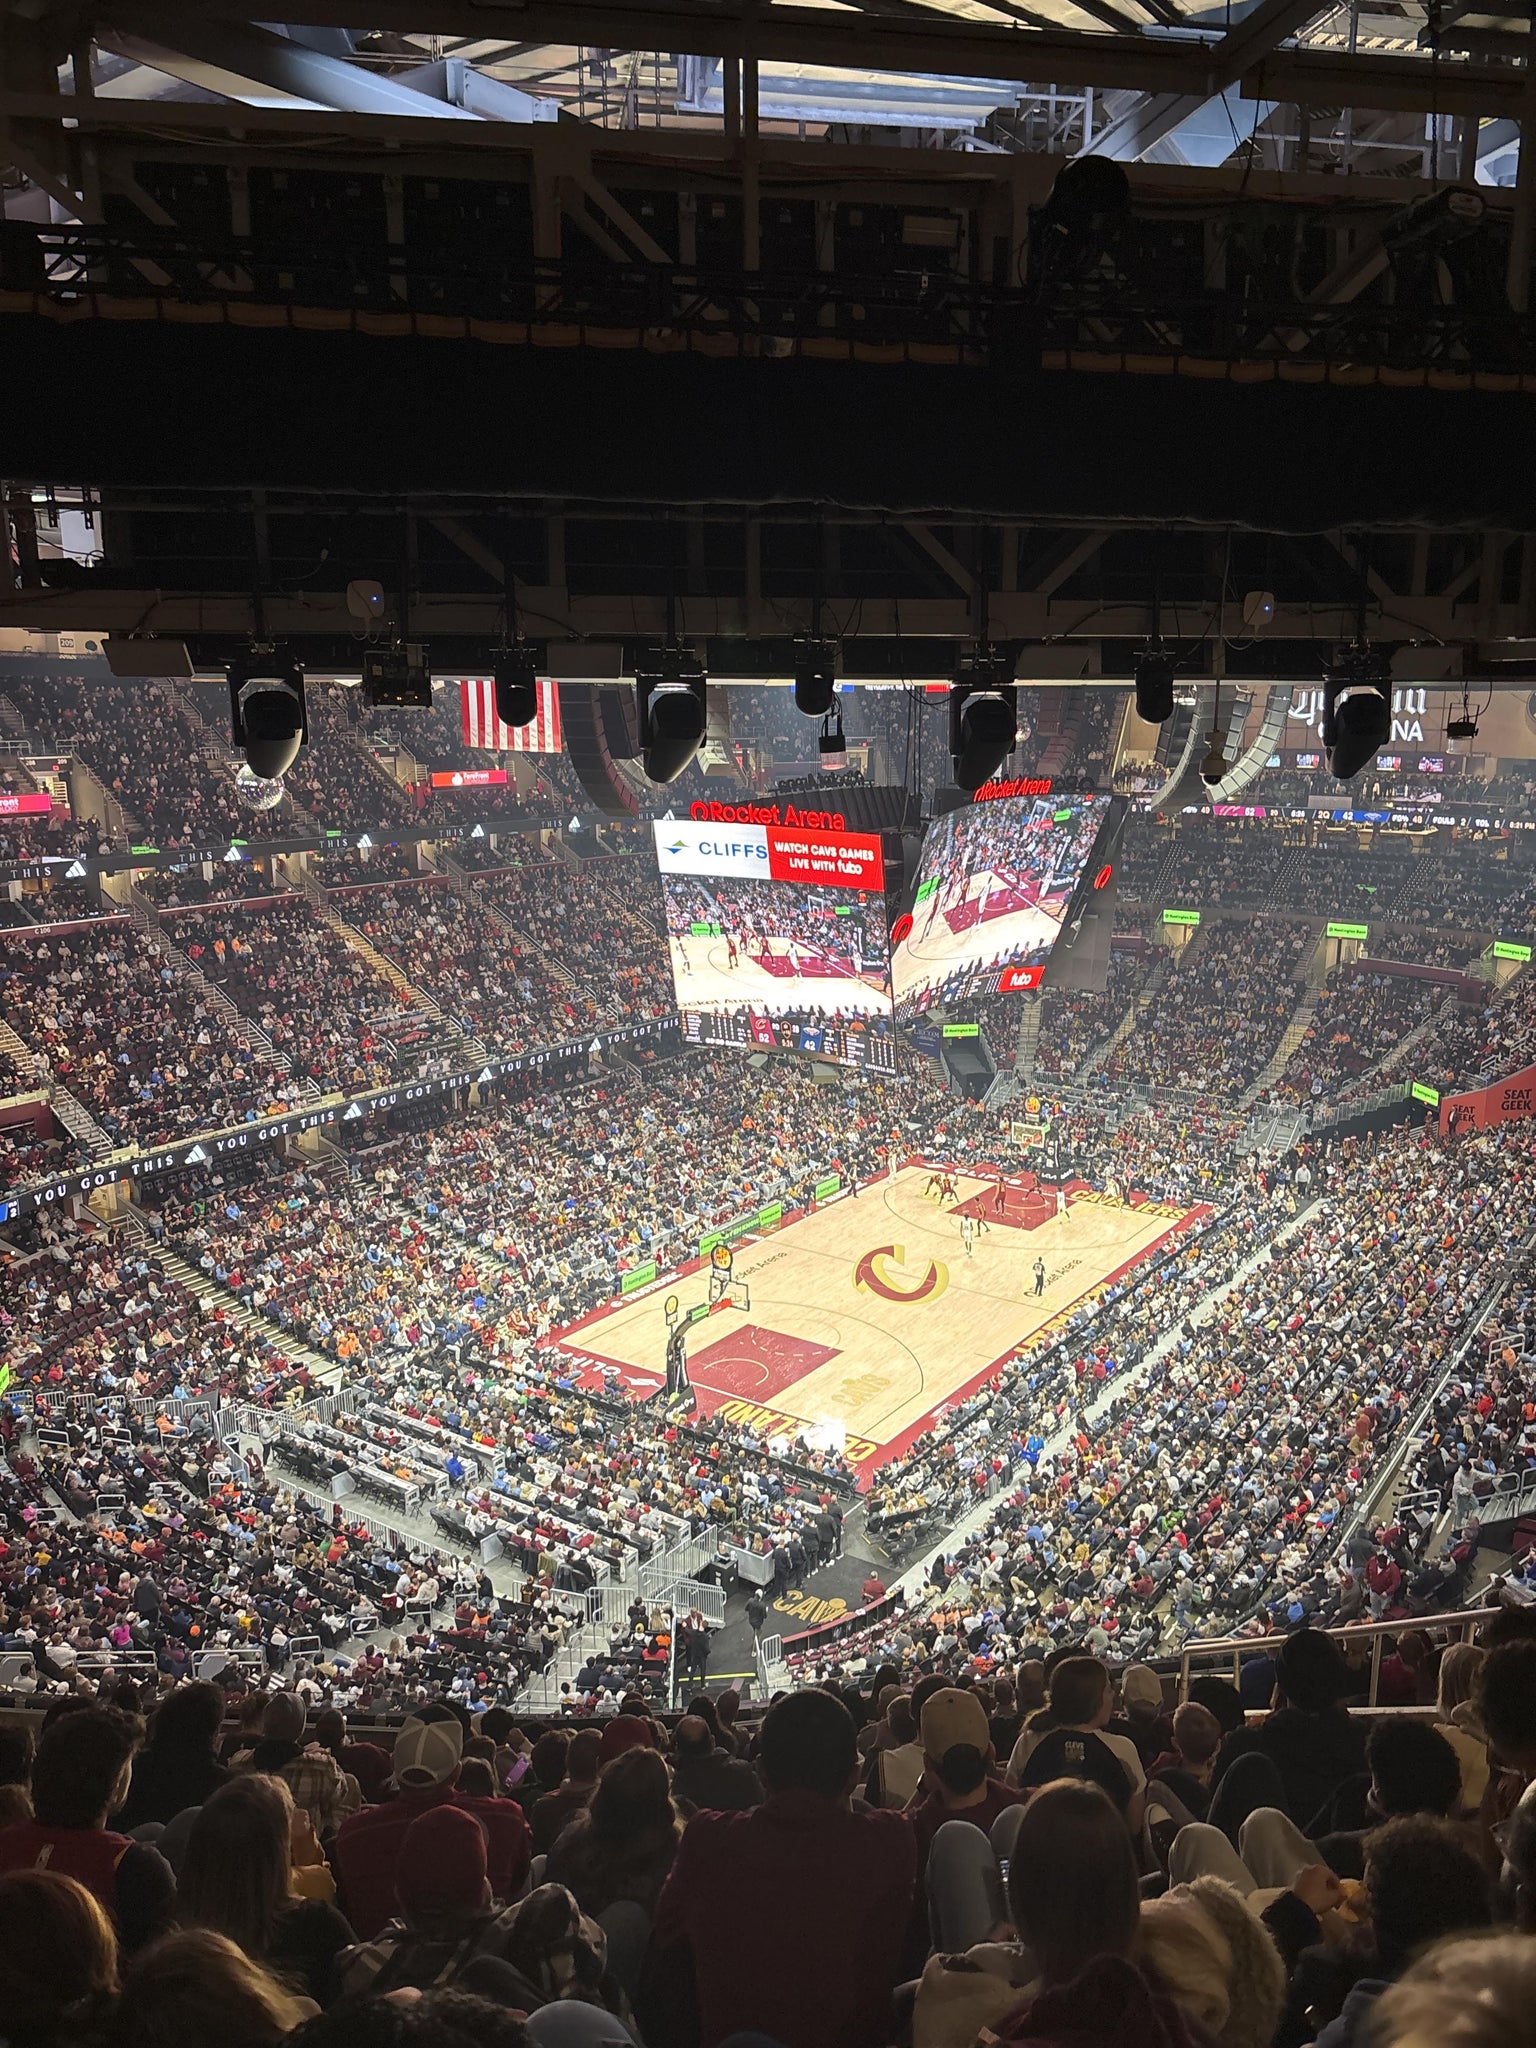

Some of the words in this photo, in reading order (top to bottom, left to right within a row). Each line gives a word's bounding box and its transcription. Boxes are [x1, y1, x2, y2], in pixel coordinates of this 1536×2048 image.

[61, 639, 74, 647] 209
[981, 778, 1019, 801] Rocket
[1017, 777, 1052, 795] Arena
[709, 801, 780, 825] Rocket
[785, 805, 845, 831] Arena
[439, 828, 464, 838] THIS
[319, 838, 349, 849] THIS
[699, 841, 768, 860] CLIFFS
[774, 841, 809, 855] WATCH
[810, 844, 838, 859] CAVS
[838, 847, 875, 862] GAMES
[179, 850, 213, 863] THIS
[10, 866, 52, 879] THIS
[789, 858, 810, 870] LIVE
[811, 859, 835, 872] WITH
[836, 859, 863, 876] fubo
[1010, 972, 1032, 987] fubo
[607, 1032, 628, 1045] YOU
[632, 1025, 652, 1038] GOT
[657, 1017, 680, 1031] THIS
[758, 1032, 770, 1043] 52
[804, 1040, 816, 1051] 42
[500, 1061, 522, 1074] YOU
[529, 1052, 551, 1066] GOT
[558, 1043, 584, 1058] THIS
[370, 1094, 397, 1110] YOU
[406, 1084, 432, 1100] GOT
[441, 1074, 471, 1090] THIS
[1504, 1089, 1532, 1100] SEAT
[1453, 1104, 1476, 1114] SEAT
[1500, 1100, 1532, 1111] GEEK
[216, 1134, 247, 1152] YOU
[258, 1123, 289, 1140] GOT
[300, 1110, 335, 1129] THIS
[33, 1184, 67, 1206] YOU
[80, 1170, 118, 1190] GOT
[131, 1154, 174, 1176] THIS
[718, 1400, 878, 1463] CLELAND
[772, 1589, 848, 1623] CAV
